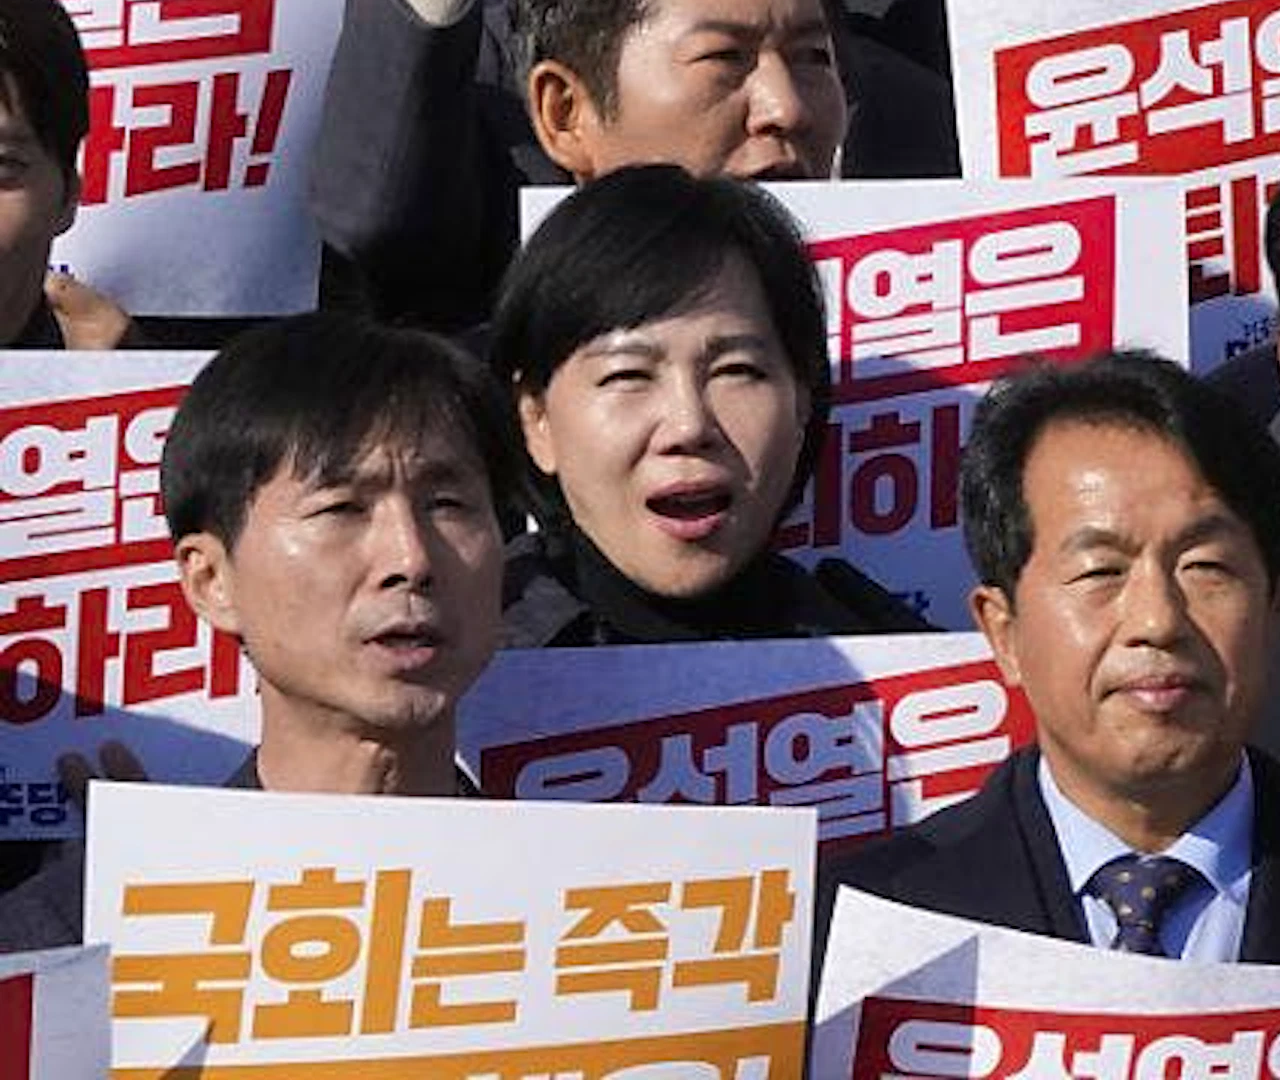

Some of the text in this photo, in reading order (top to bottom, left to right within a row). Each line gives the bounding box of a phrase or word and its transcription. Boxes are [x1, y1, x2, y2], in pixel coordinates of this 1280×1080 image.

[815, 221, 1085, 383] 열은
[112, 867, 797, 1045] 국회는 즉각
